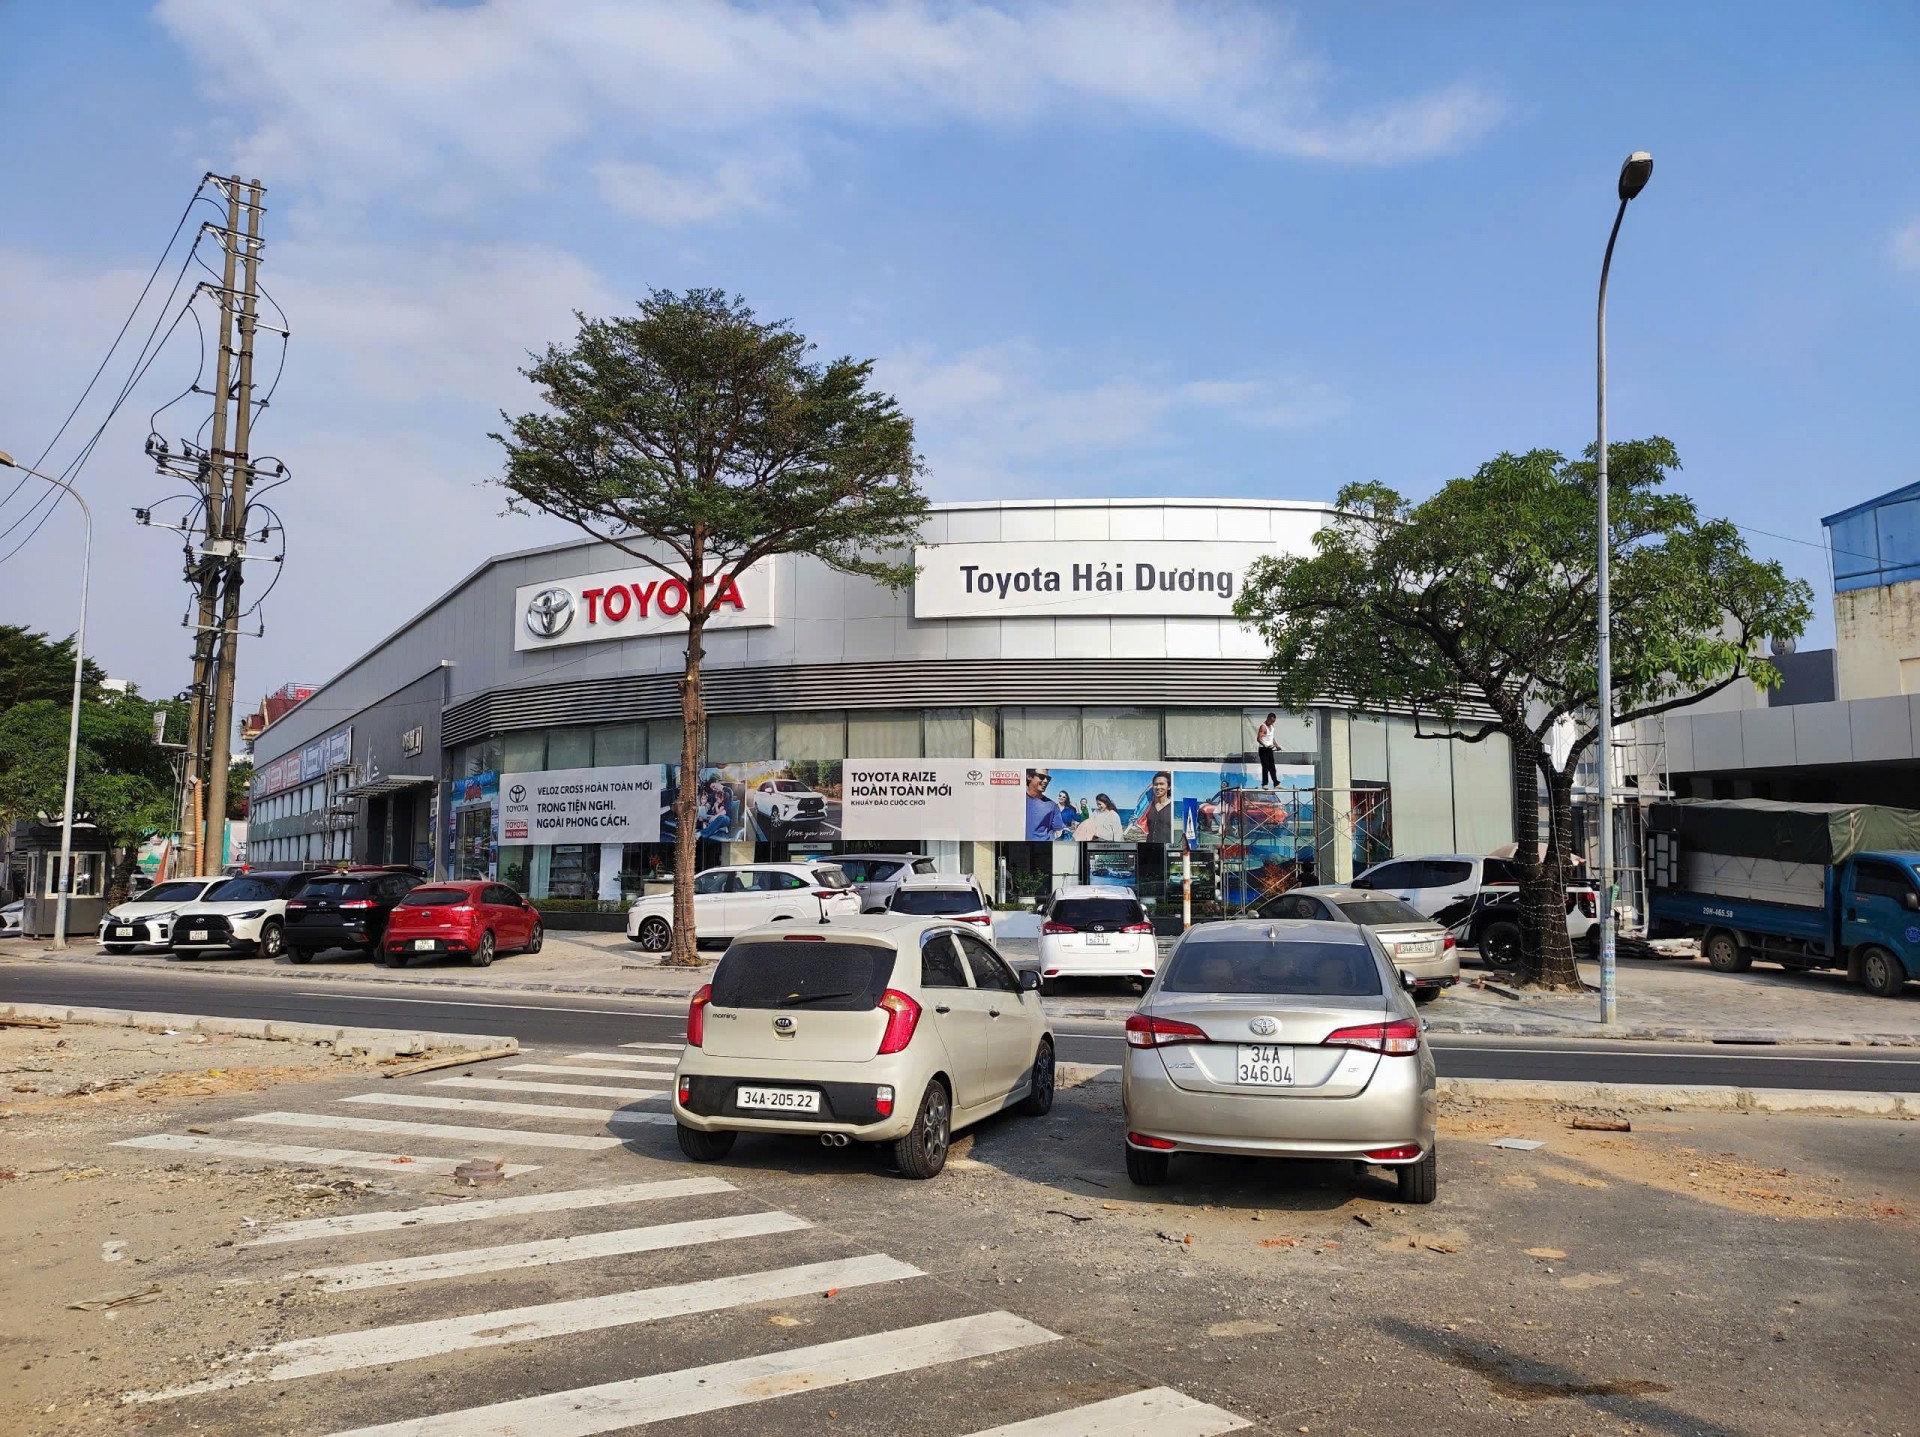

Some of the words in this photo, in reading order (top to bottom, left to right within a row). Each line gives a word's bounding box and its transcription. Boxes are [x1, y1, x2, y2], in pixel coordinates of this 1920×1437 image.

[960, 565, 1061, 600] Toyota
[1072, 562, 1123, 592] Hải
[1135, 563, 1233, 599] Dương
[851, 772, 899, 782] TOYOTA
[902, 771, 937, 782] RAIZE
[537, 786, 560, 796] VELOZ
[560, 784, 584, 795] CROSS
[585, 781, 608, 793] HOÀN
[611, 782, 634, 792] TOÀN
[635, 780, 653, 790] MỚI
[851, 784, 888, 796] HOÀN
[890, 783, 925, 796] TOÀN
[926, 783, 952, 796] MỚI
[506, 805, 529, 813] TOYOTA
[537, 802, 566, 813] TRONG
[567, 798, 587, 814] TIỆN
[588, 800, 616, 811] NGHI.
[506, 821, 528, 829] TOYOTA
[536, 815, 564, 829] NGOÀI
[565, 816, 598, 827] PHONG
[600, 813, 630, 826] CÁCH.
[712, 1012, 737, 1020] morning
[1251, 1046, 1281, 1064] 34A
[1239, 1065, 1293, 1084] 346.04
[744, 1091, 813, 1108] 34A-205.22
